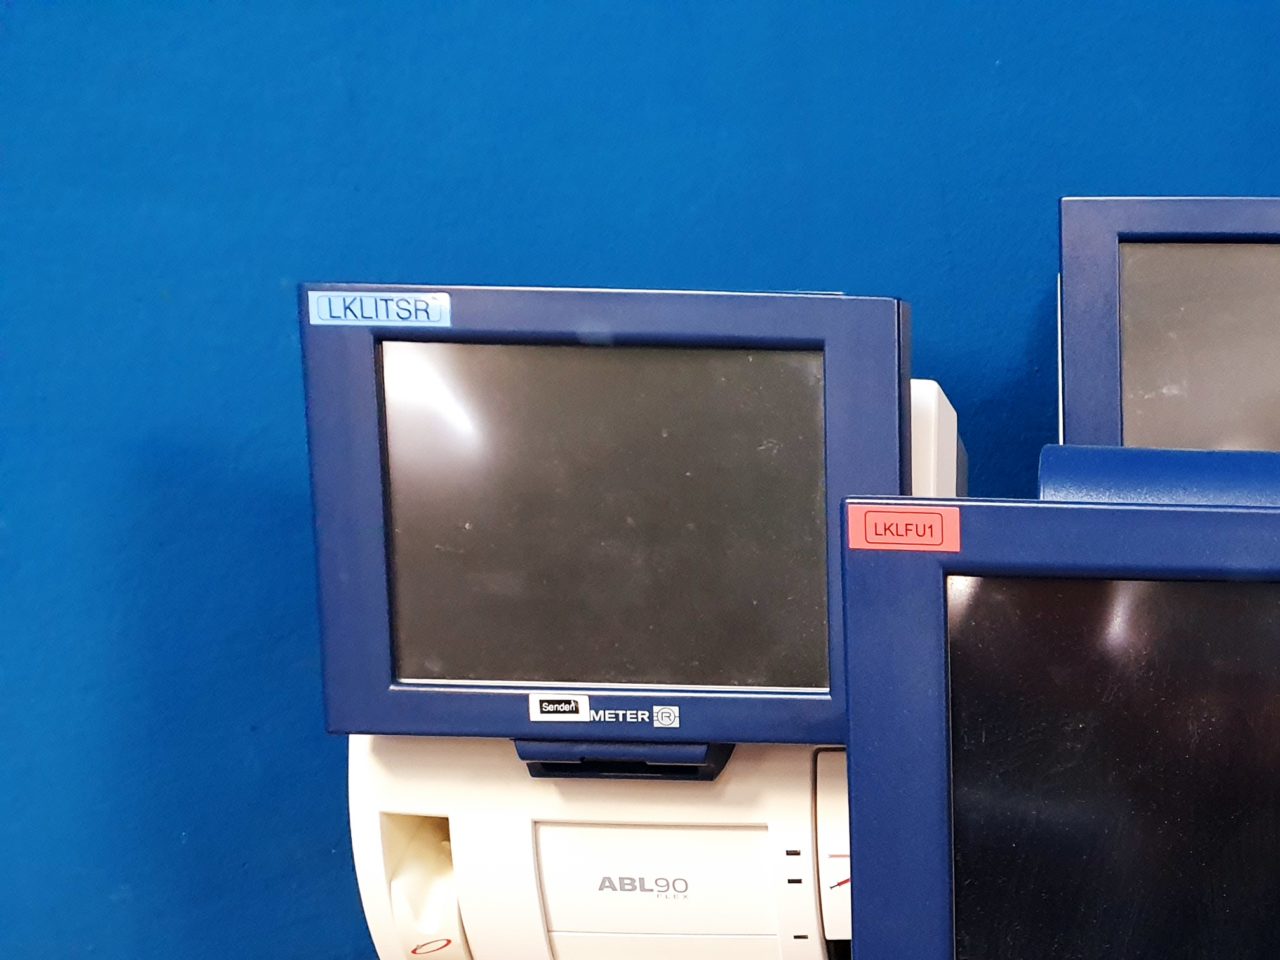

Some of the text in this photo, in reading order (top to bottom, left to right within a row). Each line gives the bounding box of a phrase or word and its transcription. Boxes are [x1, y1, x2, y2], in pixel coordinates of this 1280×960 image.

[328, 297, 431, 320] LKLITSR
[874, 522, 934, 538] LKLFU1
[598, 876, 689, 893] ABL90
